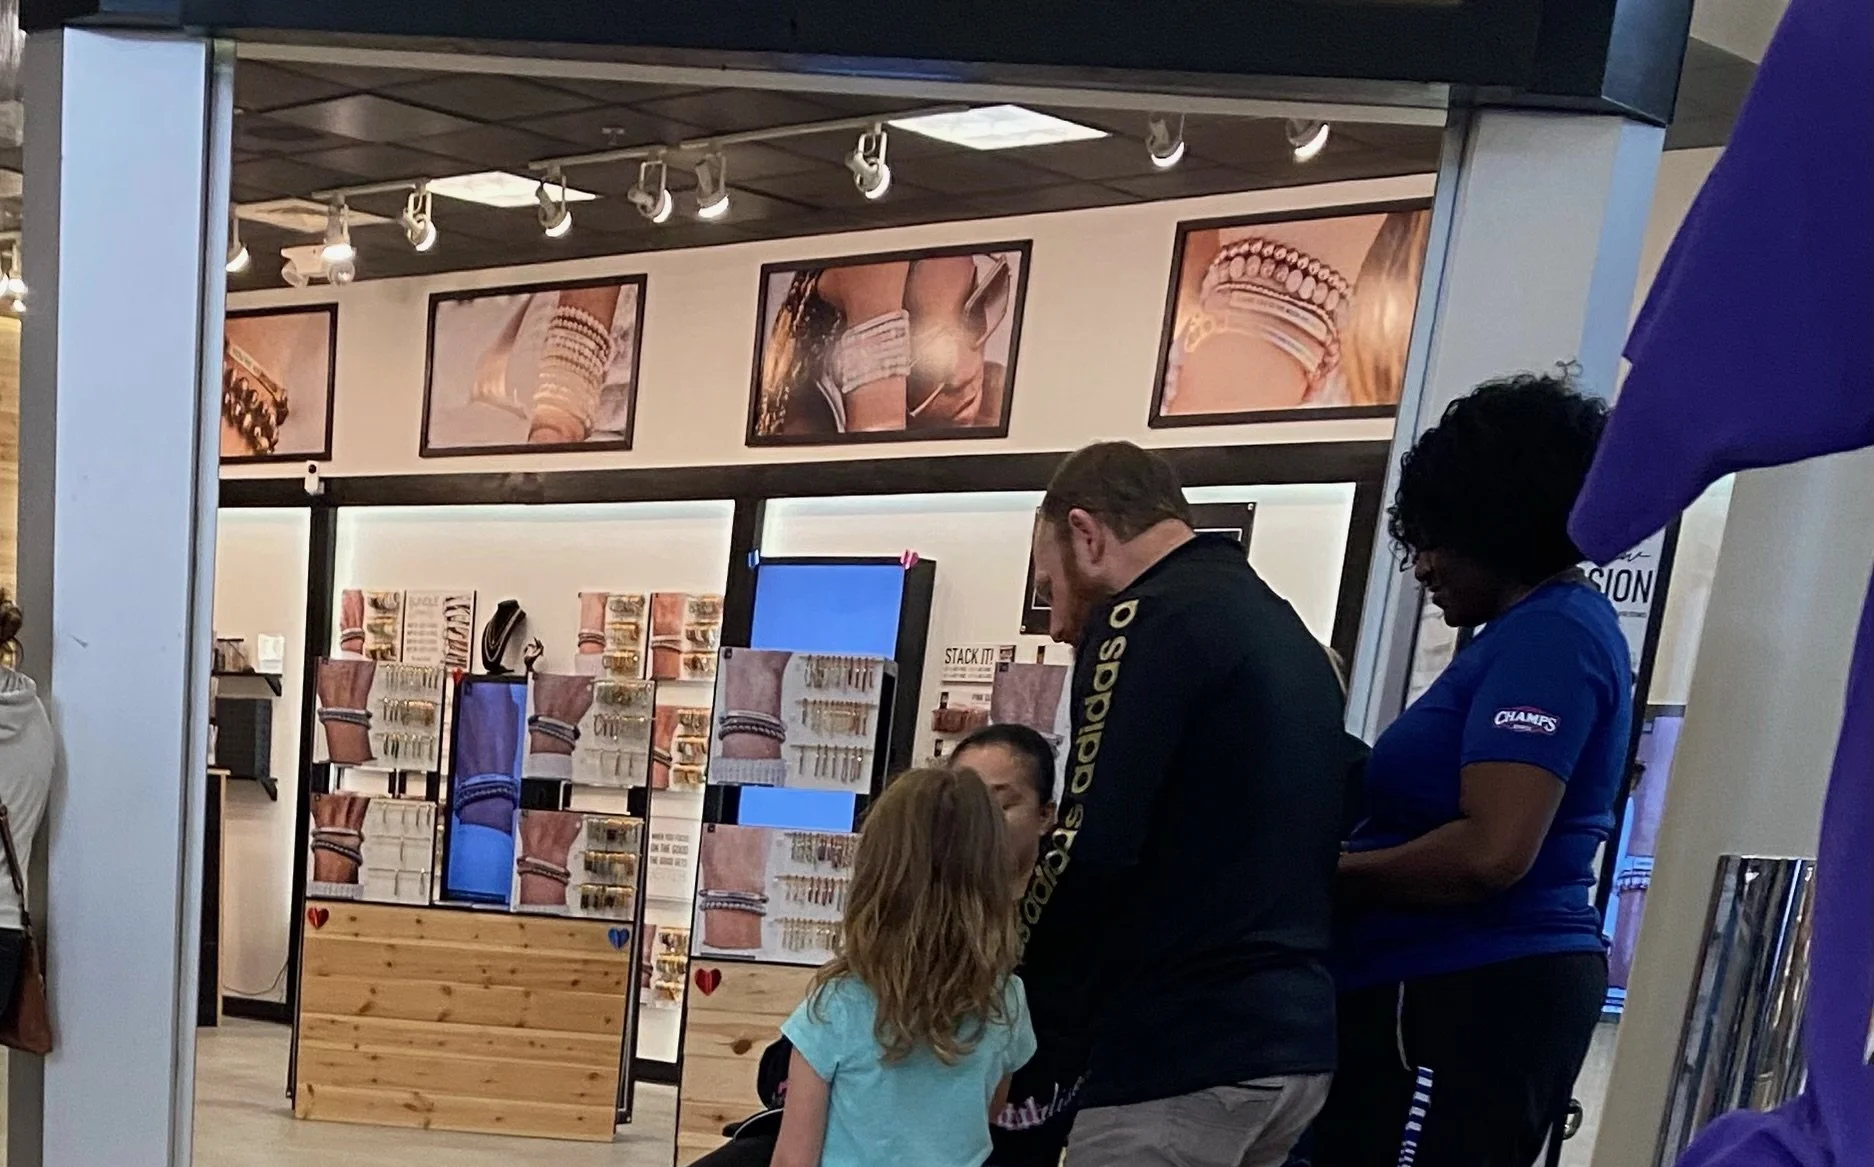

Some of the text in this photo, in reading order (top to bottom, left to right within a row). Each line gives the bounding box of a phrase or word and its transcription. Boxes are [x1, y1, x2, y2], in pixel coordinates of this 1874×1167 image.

[1588, 567, 1653, 603] SION
[945, 647, 979, 665] STACK
[980, 648, 994, 665] IT!
[1071, 635, 1128, 795] adidas
[1494, 710, 1557, 732] CHAMPS
